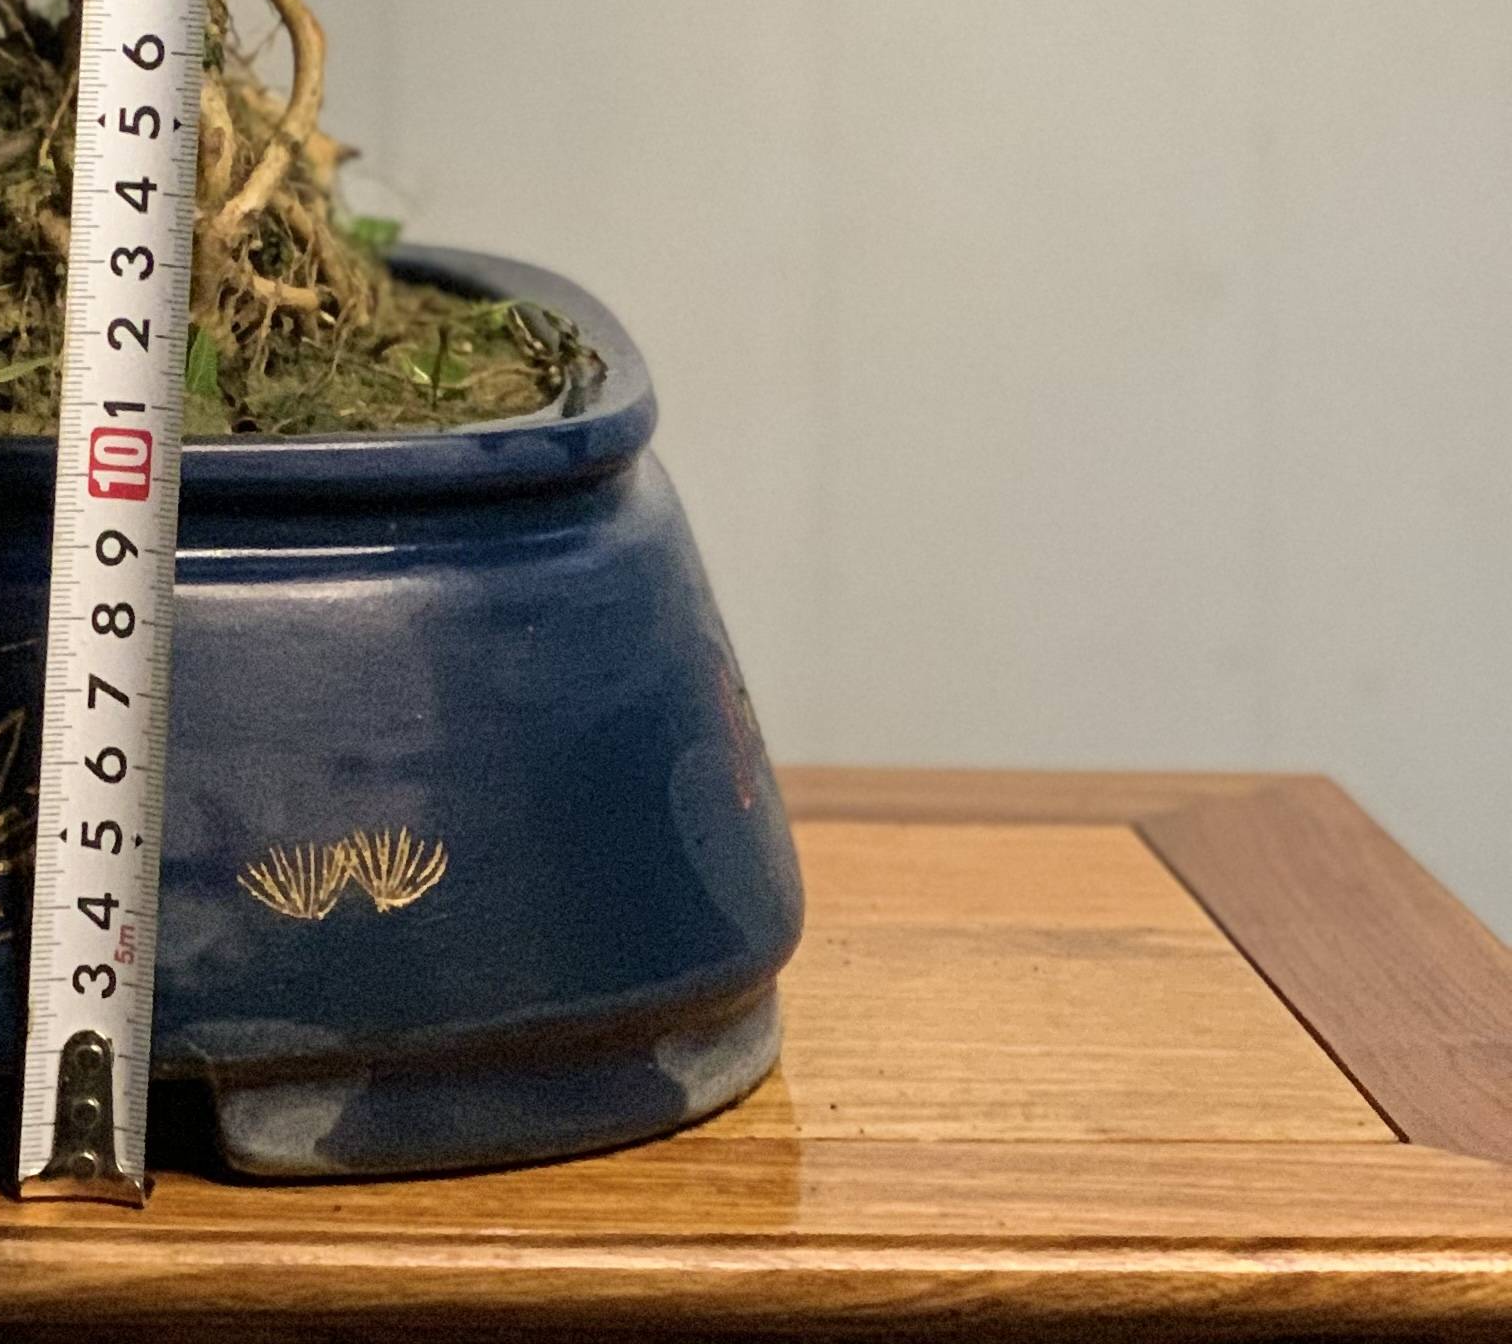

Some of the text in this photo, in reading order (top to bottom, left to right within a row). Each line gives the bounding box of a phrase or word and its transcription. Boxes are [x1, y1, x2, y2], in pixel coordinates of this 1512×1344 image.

[123, 34, 165, 71] 6
[119, 106, 161, 140] 5
[115, 176, 158, 214] 4
[110, 246, 155, 281] 3
[107, 318, 151, 353] 2
[103, 401, 146, 417] 1
[92, 432, 149, 493] 10
[96, 529, 139, 566] 9
[91, 602, 136, 639] 8
[88, 673, 131, 709] 7
[84, 746, 127, 784] 6
[81, 820, 123, 856] 5
[77, 892, 120, 931] 4
[114, 924, 136, 965] 5m
[72, 963, 117, 999] 3
